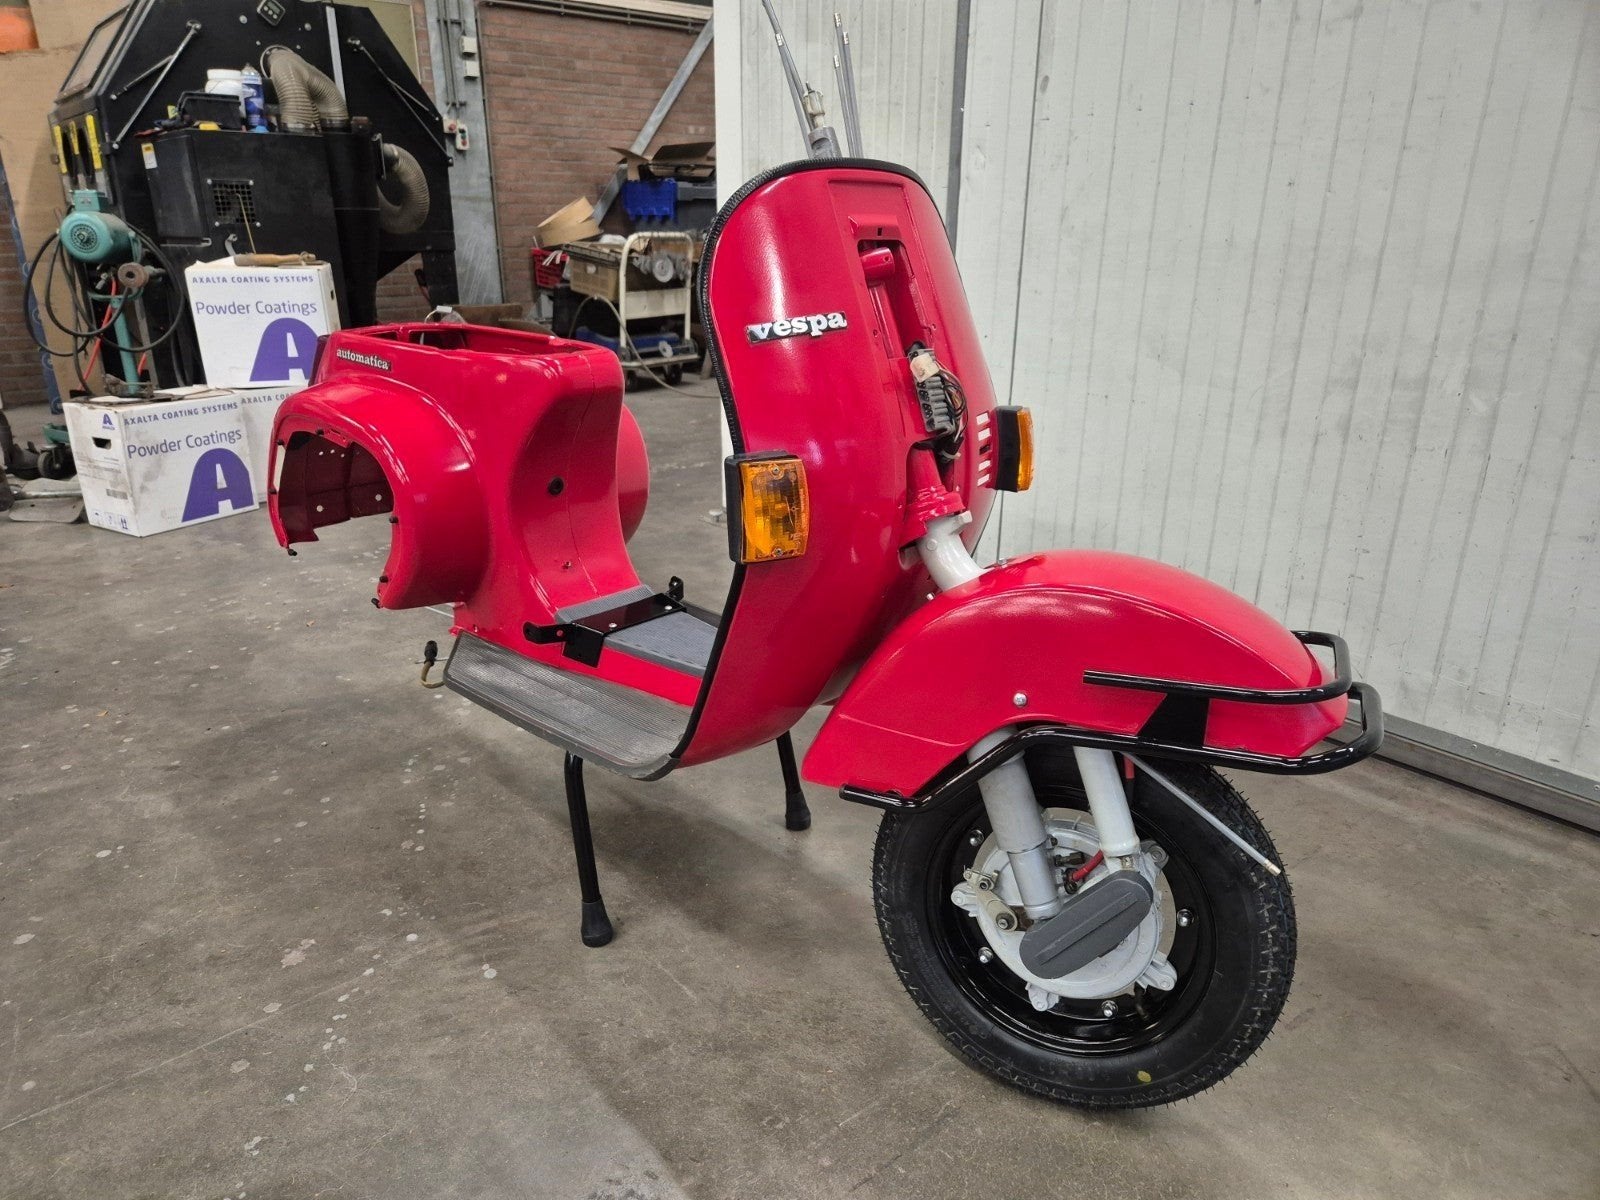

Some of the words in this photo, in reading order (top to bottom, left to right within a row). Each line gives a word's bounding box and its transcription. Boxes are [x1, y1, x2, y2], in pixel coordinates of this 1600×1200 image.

[196, 301, 251, 314] Powder
[256, 300, 317, 316] Coatings
[747, 312, 848, 340] vespa
[250, 318, 318, 381] A
[336, 348, 389, 370] automatica
[241, 395, 272, 404] AXALTA
[124, 414, 159, 426] AXALTA
[162, 409, 199, 419] COATING
[202, 402, 238, 414] SYSTEMS
[128, 440, 182, 458] Powder
[186, 428, 242, 448] Coatings
[182, 448, 254, 522] A
